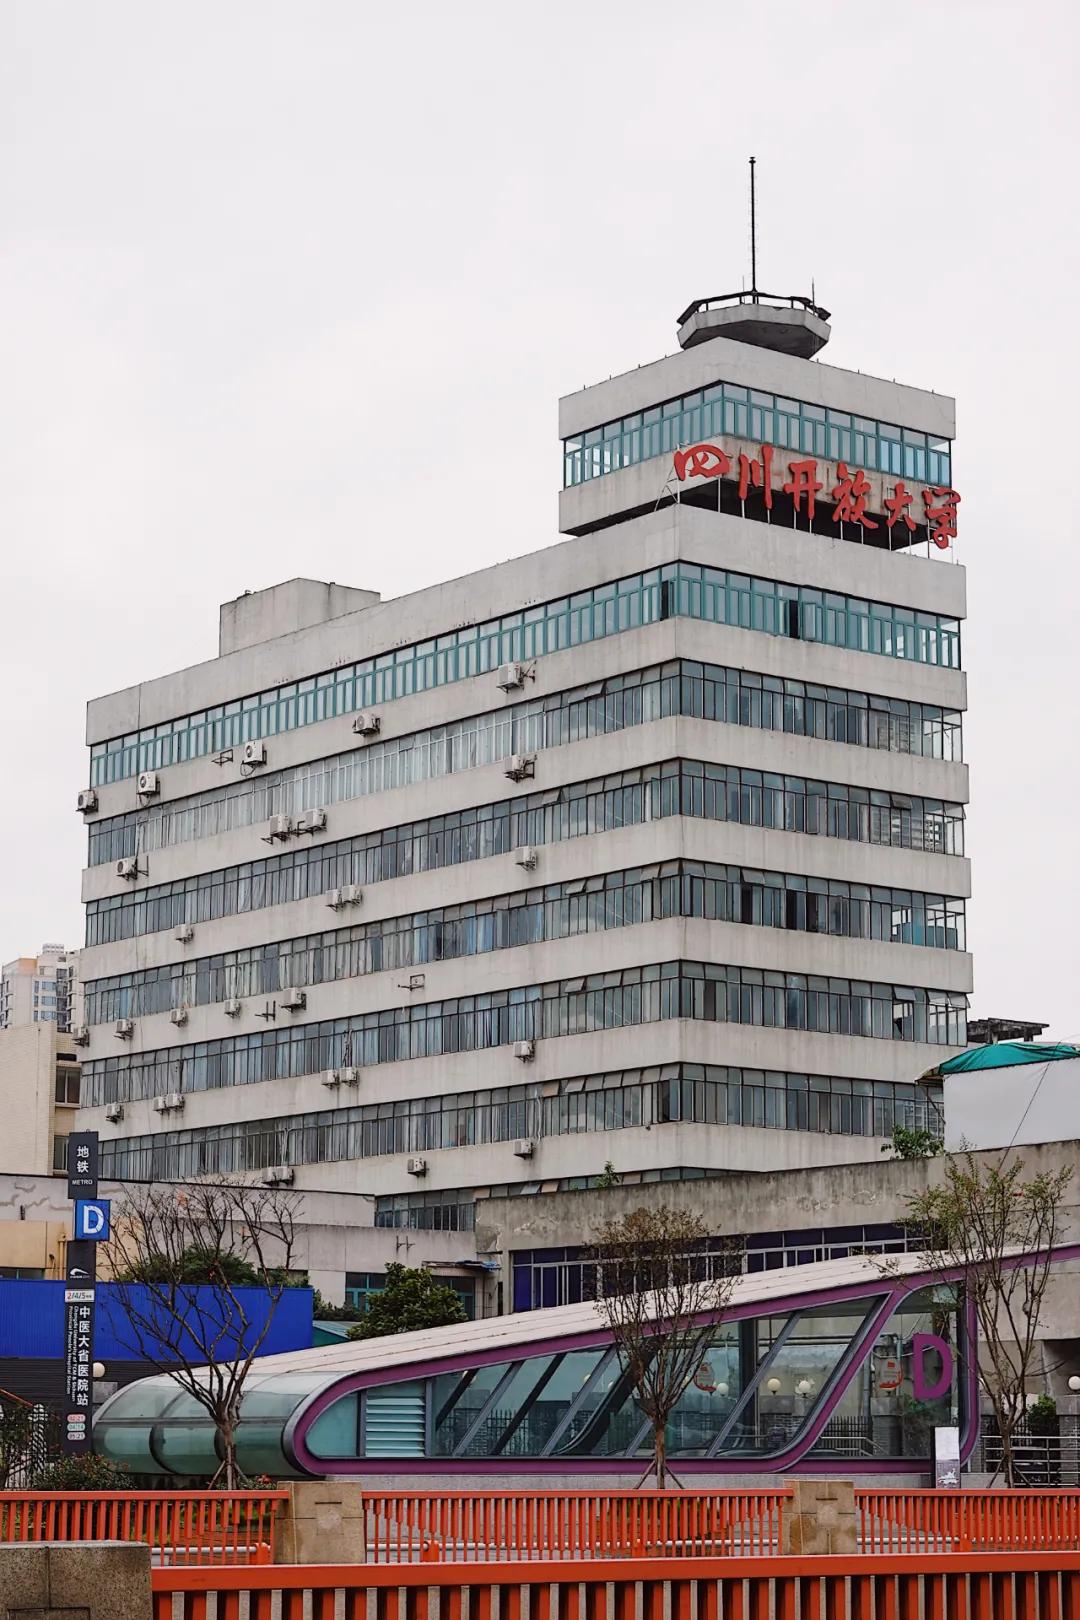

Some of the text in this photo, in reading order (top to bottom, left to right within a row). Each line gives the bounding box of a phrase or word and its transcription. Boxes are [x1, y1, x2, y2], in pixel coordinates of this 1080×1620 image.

[674, 444, 961, 549] 四川开放大学
[76, 1145, 90, 1173] 地铁
[83, 1205, 104, 1234] D
[77, 1306, 90, 1407] 中医大省医院站
[912, 1333, 952, 1399] D
